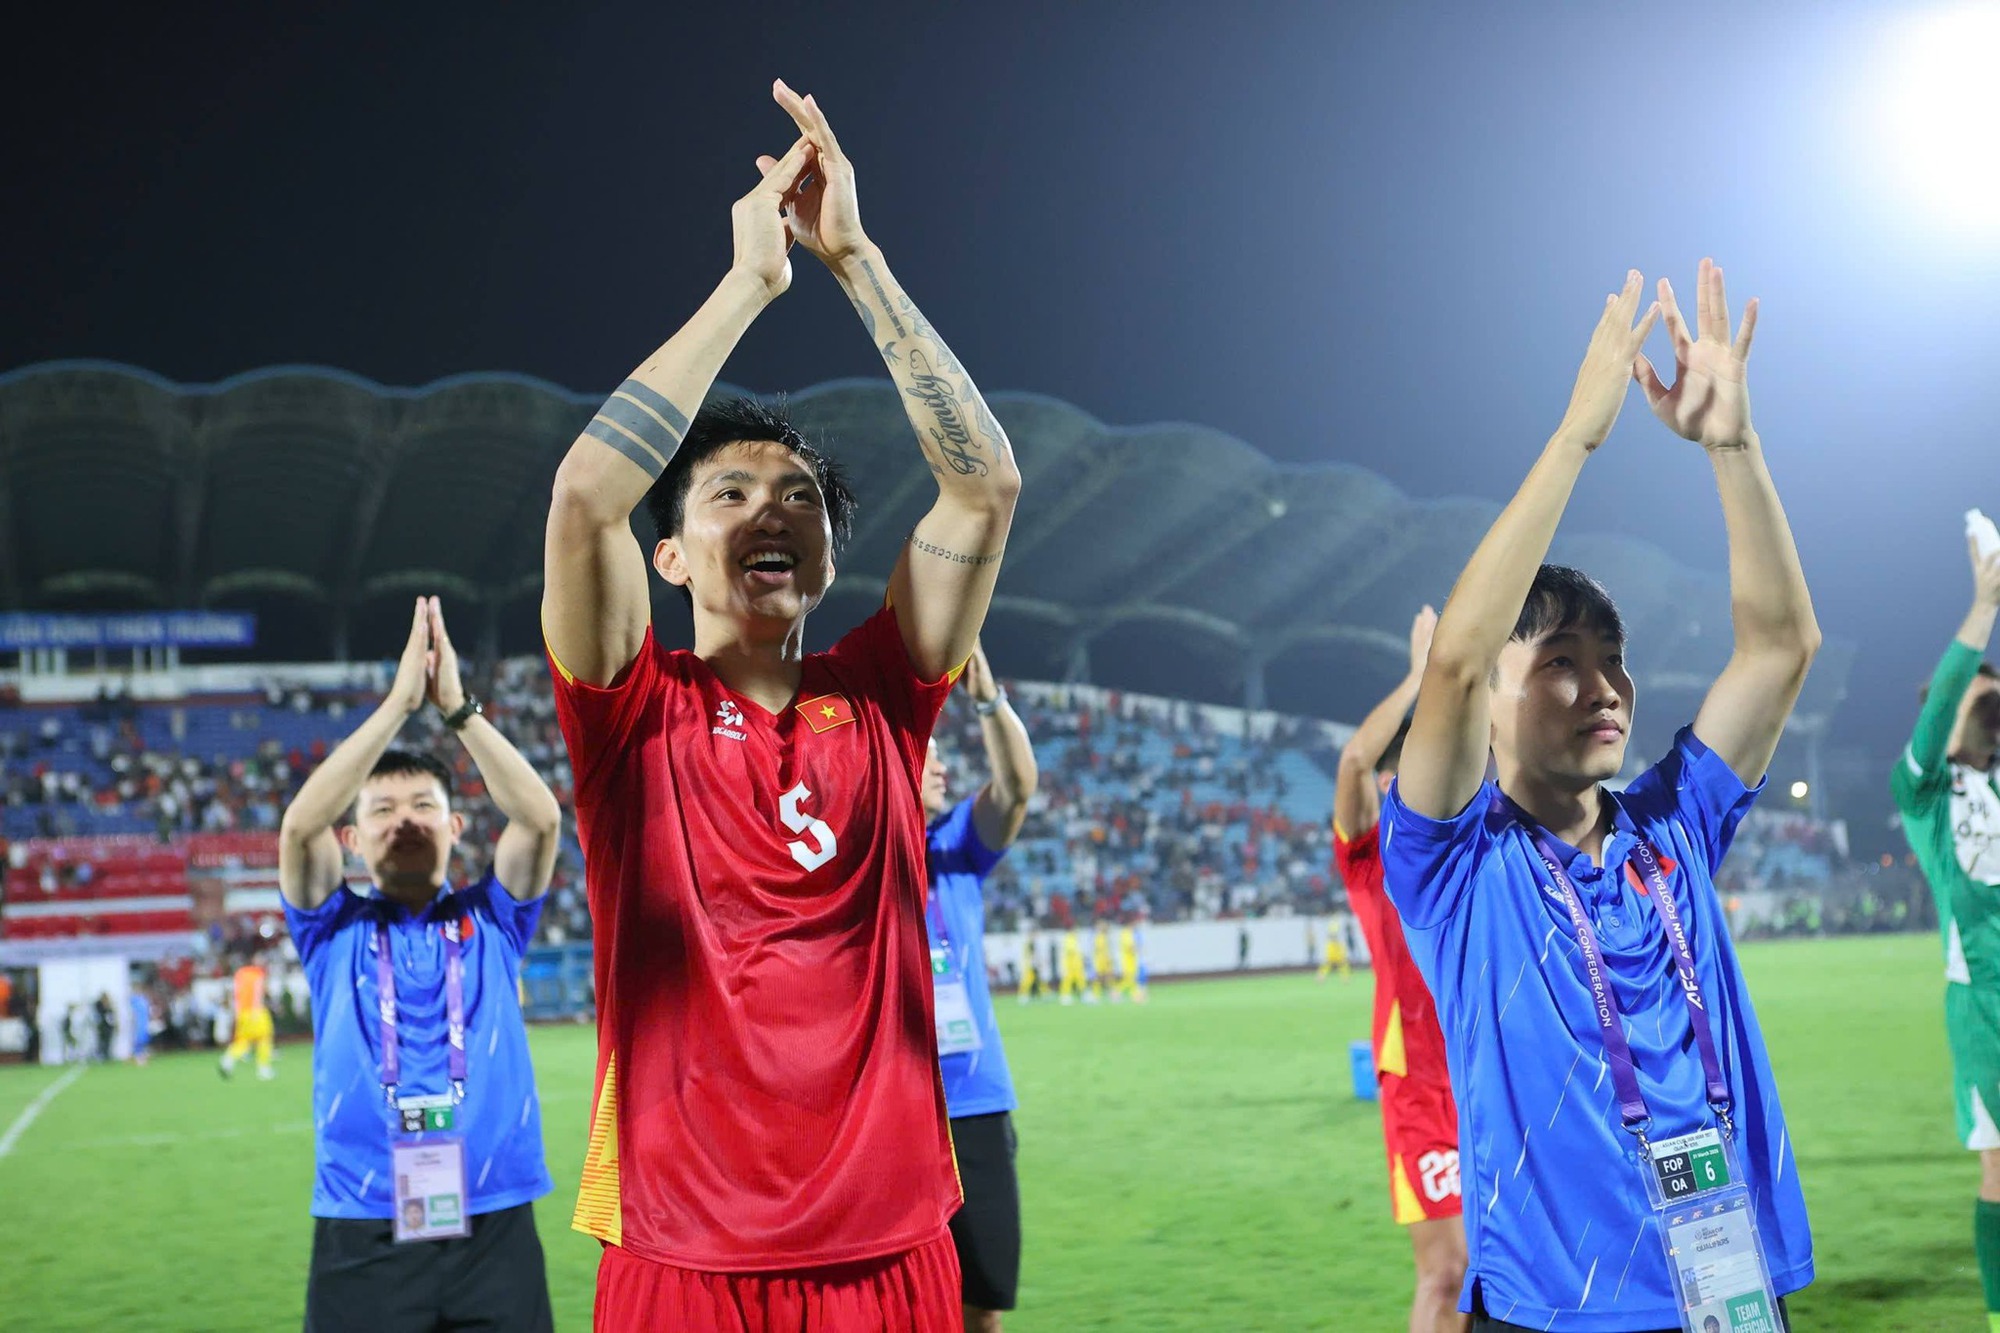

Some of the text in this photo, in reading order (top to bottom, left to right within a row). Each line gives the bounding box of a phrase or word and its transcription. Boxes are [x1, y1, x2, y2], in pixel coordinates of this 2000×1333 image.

[905, 349, 988, 477] Family
[778, 779, 838, 873] 5
[1649, 864, 1679, 921] FOOTBALL
[1552, 870, 1583, 926] FOOTBALL
[1578, 927, 1612, 1028] CONFEDERATION
[1672, 924, 1690, 959] ASIAN
[1679, 966, 1704, 1011] AFC
[1662, 1157, 1684, 1173] FOP
[1671, 1177, 1688, 1192] OA
[1704, 1160, 1716, 1182] 6
[1734, 1301, 1761, 1323] TEAM
